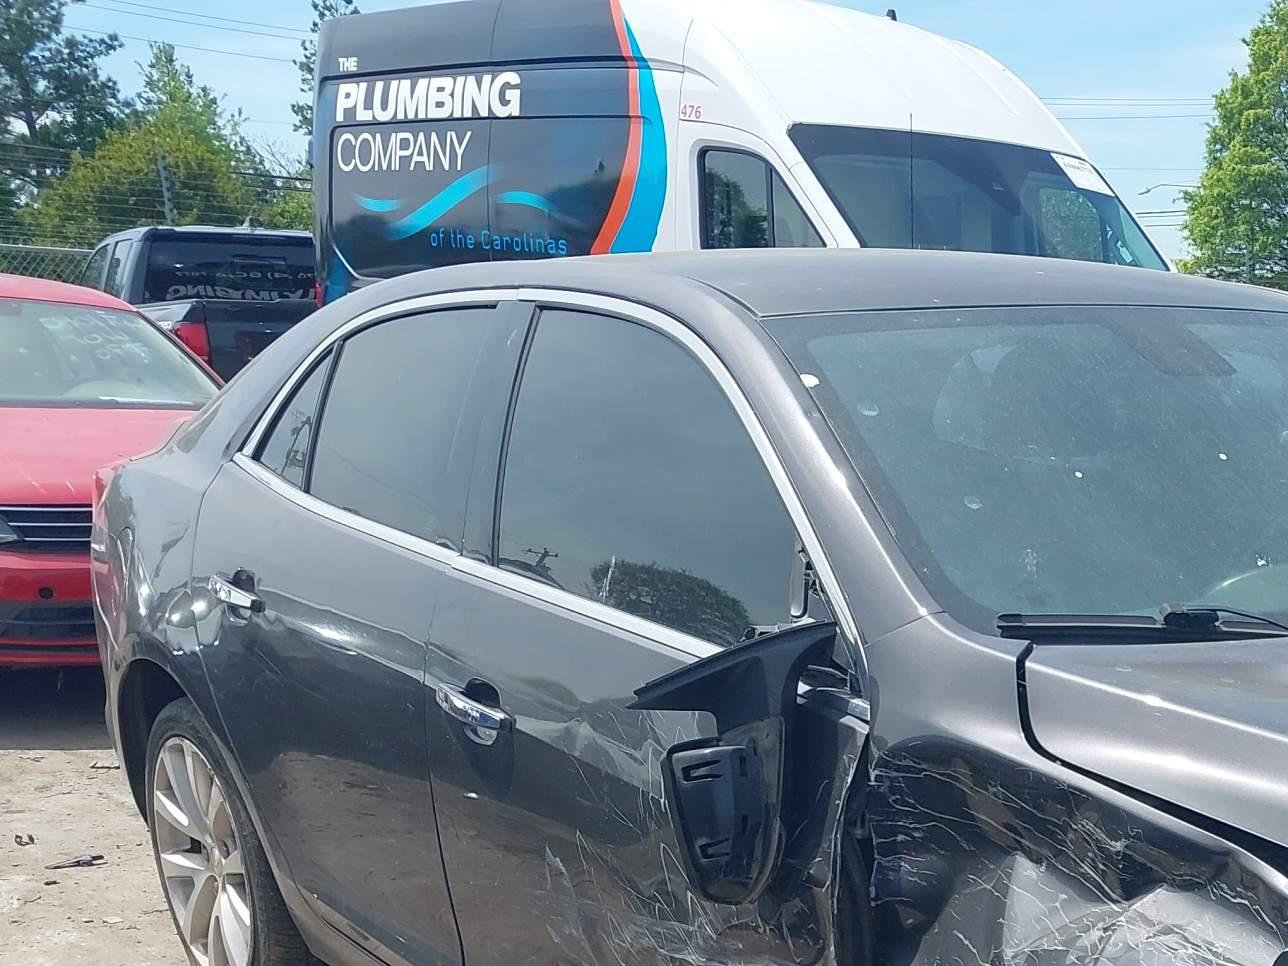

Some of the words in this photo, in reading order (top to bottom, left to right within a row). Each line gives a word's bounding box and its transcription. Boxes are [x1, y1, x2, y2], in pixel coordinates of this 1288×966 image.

[338, 57, 359, 72] THE
[335, 71, 521, 122] PLUMBING
[680, 104, 702, 120] 476
[337, 130, 472, 172] COMPANY
[430, 228, 444, 247] of
[450, 228, 475, 249] the
[481, 230, 568, 255] Carolinas
